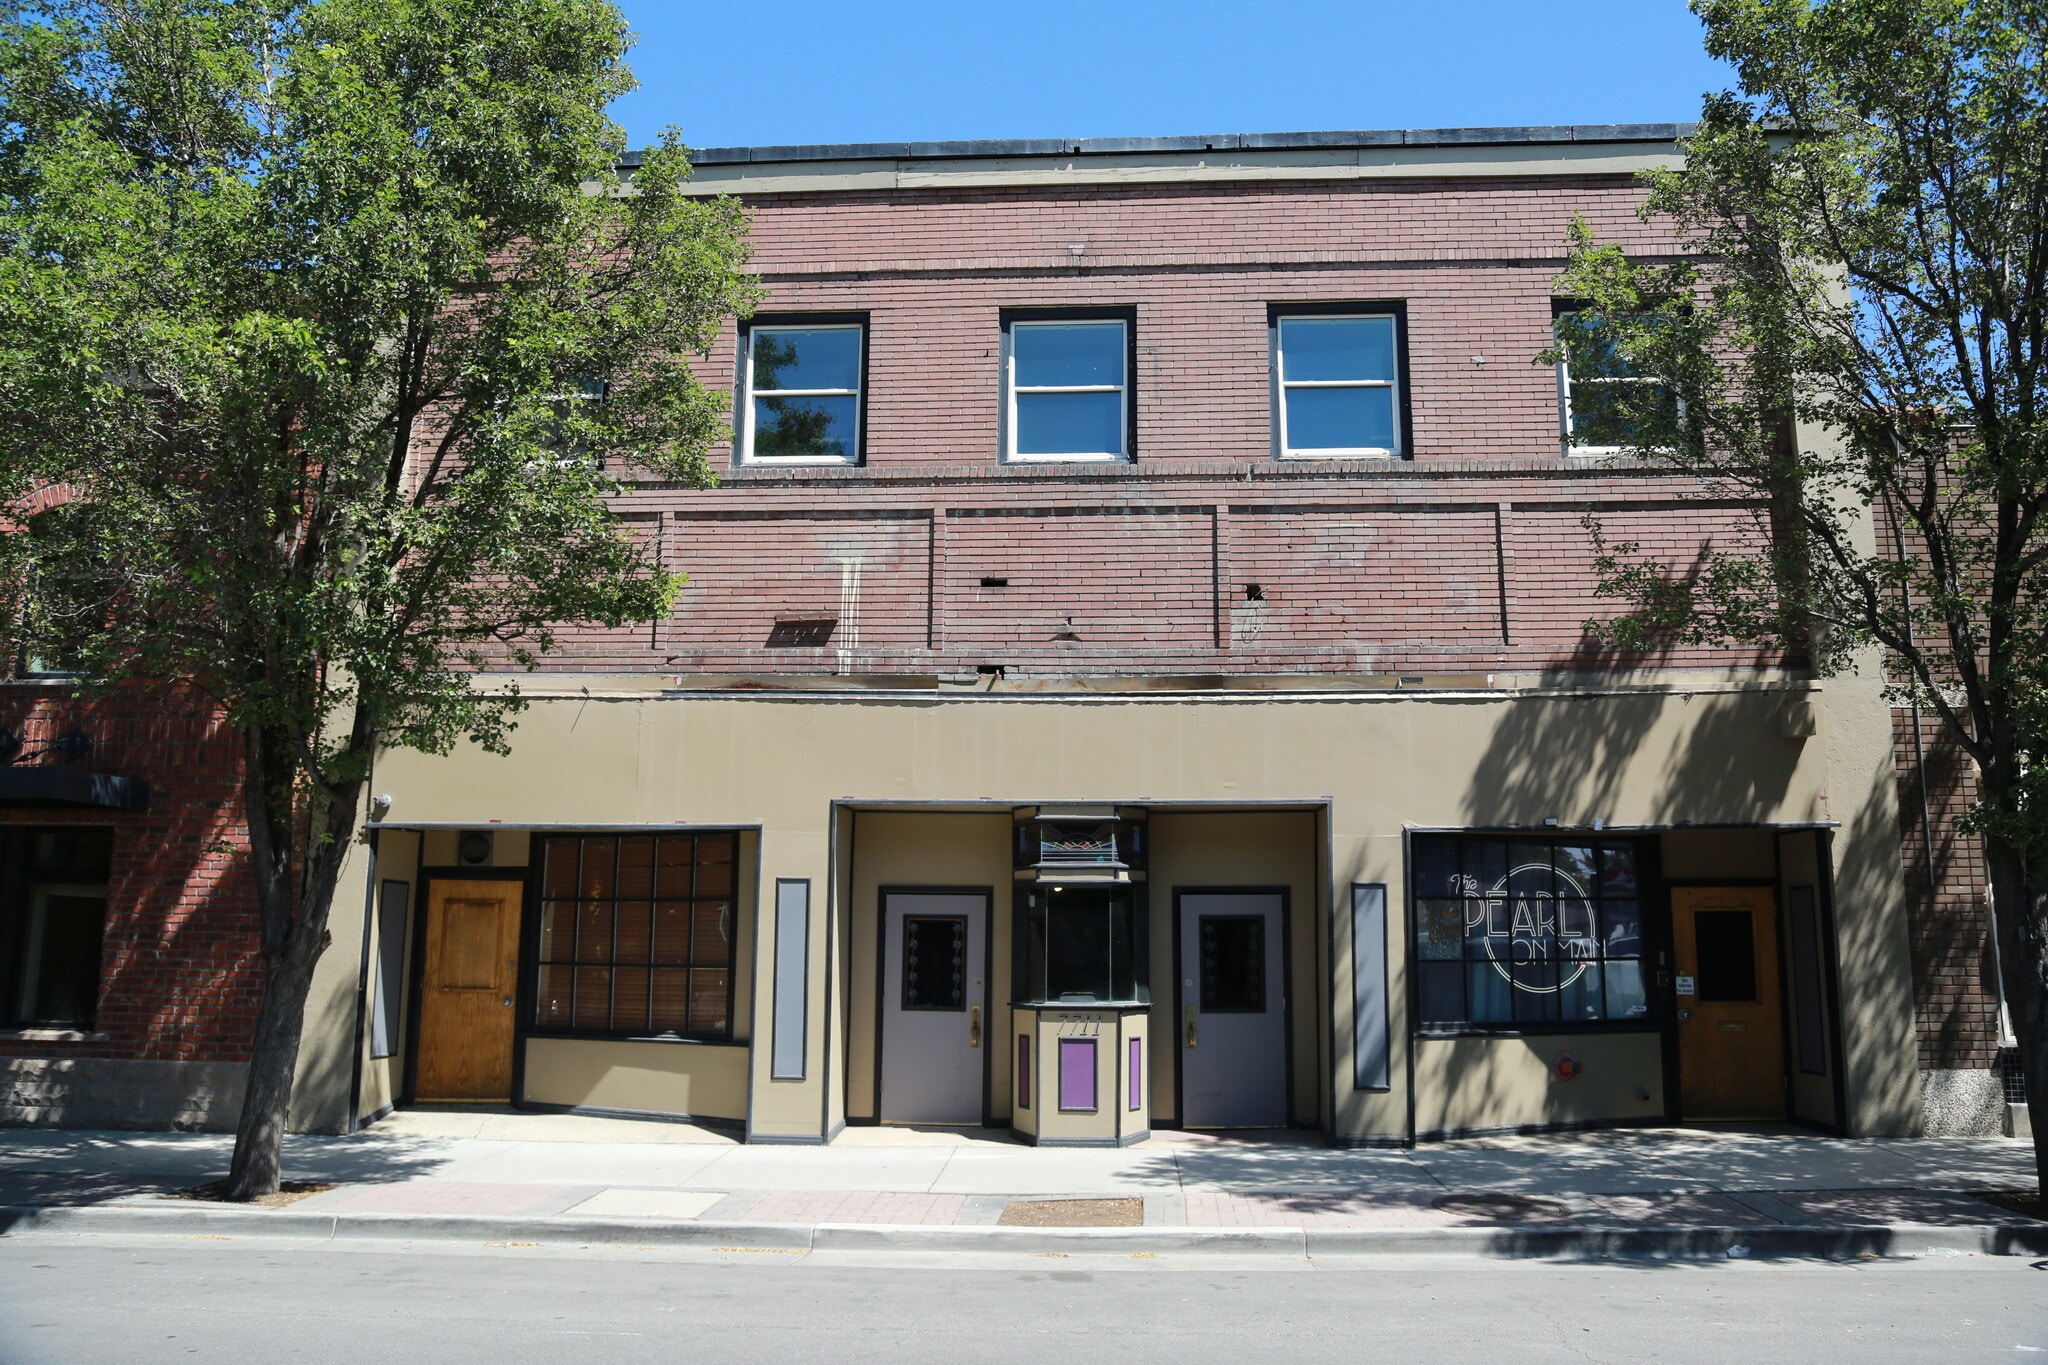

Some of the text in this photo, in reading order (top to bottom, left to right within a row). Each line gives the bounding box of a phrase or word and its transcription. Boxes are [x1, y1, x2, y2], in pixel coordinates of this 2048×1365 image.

[1450, 874, 1479, 894] The
[1463, 891, 1582, 937] PEARL
[1511, 939, 1607, 966] ON MAIN
